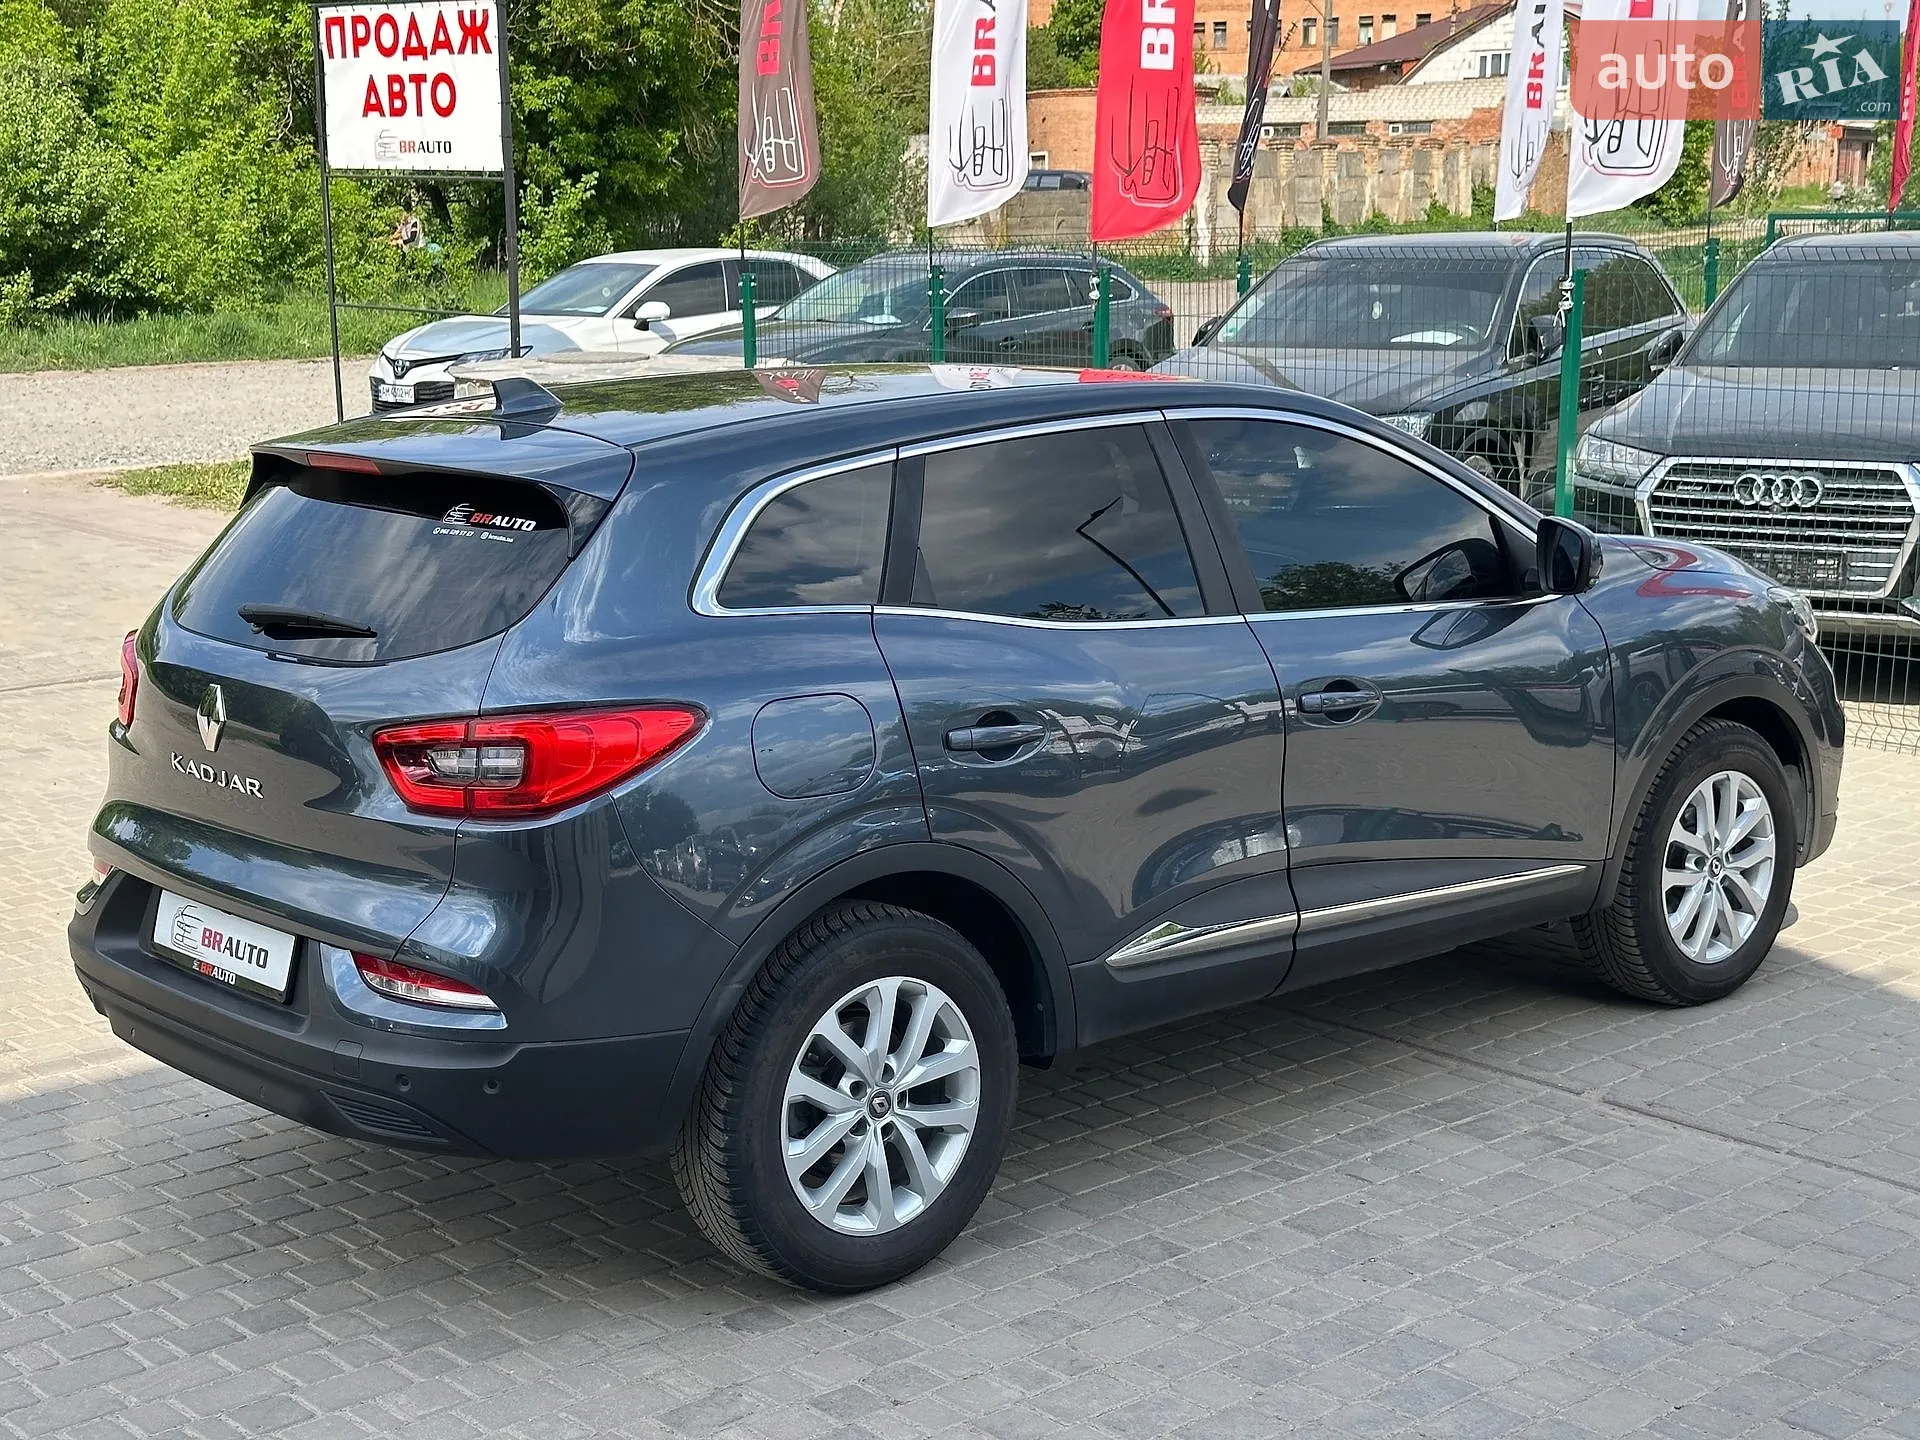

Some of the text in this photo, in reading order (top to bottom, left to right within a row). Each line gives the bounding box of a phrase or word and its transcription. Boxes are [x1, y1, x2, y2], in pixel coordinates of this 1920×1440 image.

[325, 9, 493, 61] ПРОДАЖ
[362, 72, 457, 118] АВТО
[399, 140, 452, 154] BRAUTO
[469, 512, 537, 531] BRAUTO
[171, 751, 264, 799] KADJAR
[201, 927, 269, 969] BRAUTO
[200, 962, 236, 985] BRAUTO
